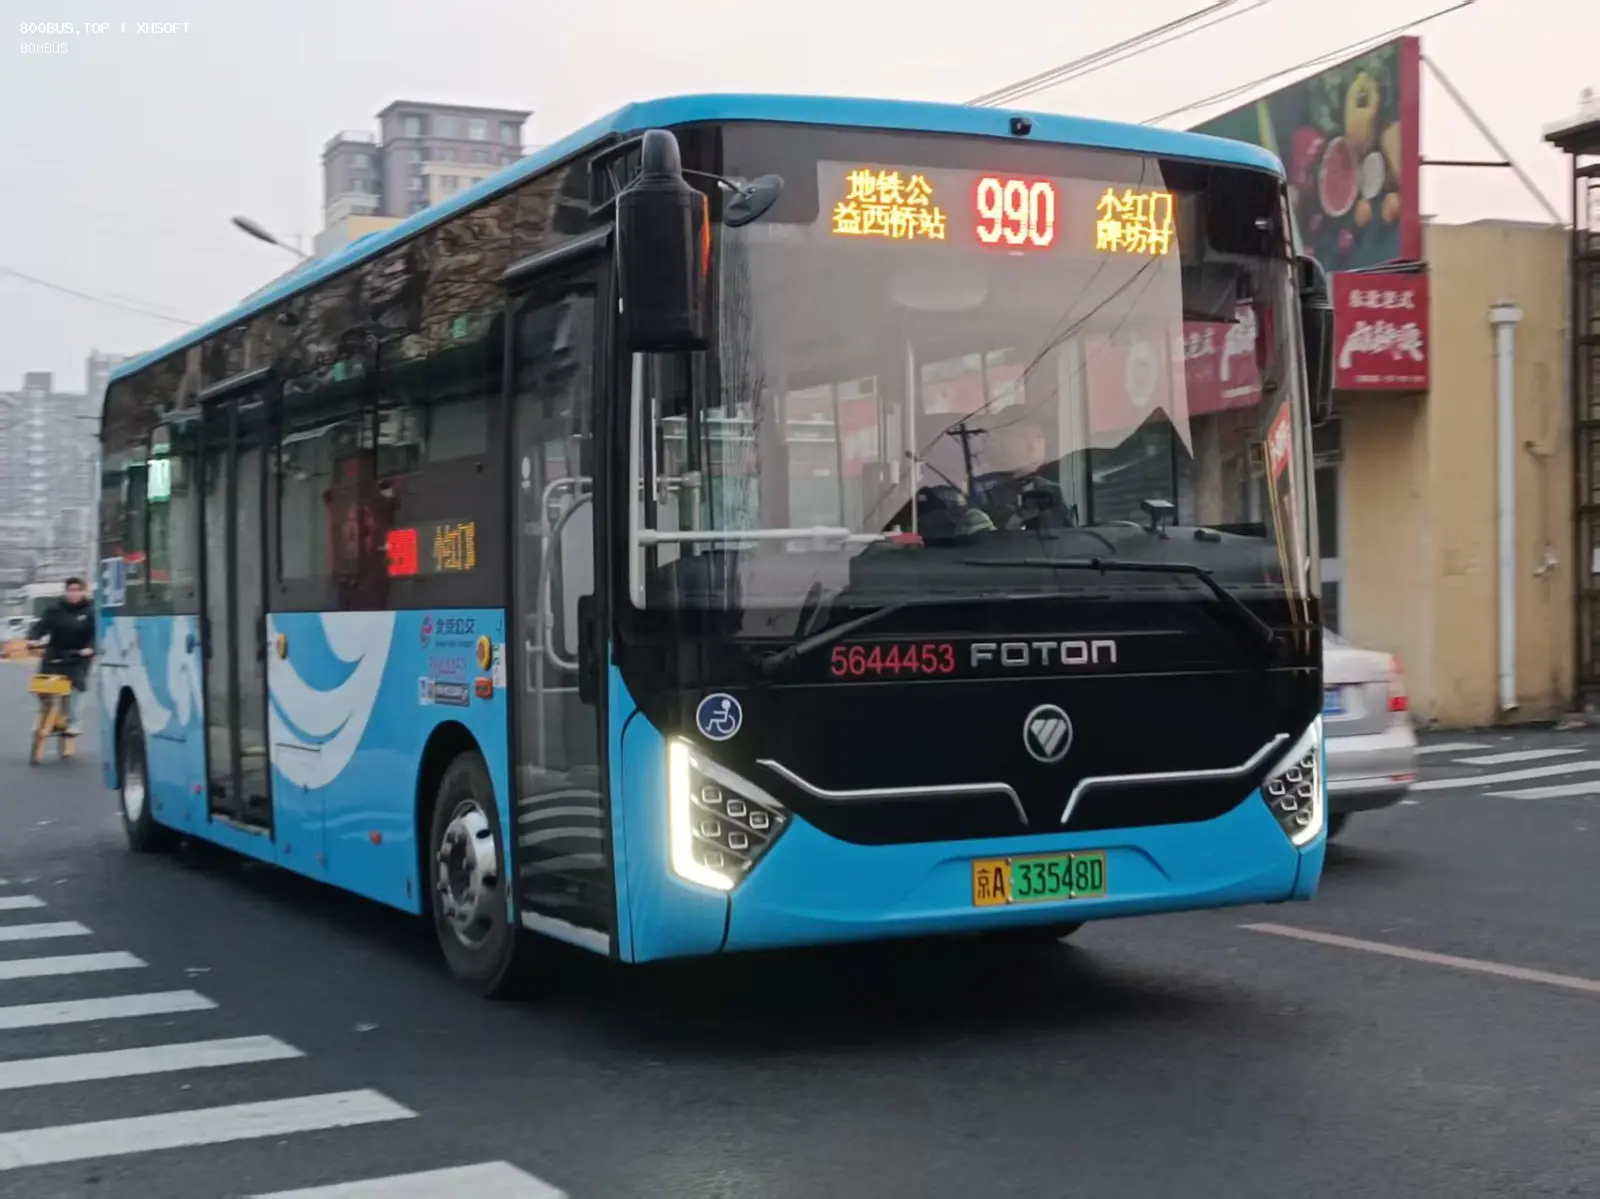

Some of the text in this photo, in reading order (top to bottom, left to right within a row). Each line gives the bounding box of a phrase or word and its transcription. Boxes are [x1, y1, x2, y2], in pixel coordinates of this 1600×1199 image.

[846, 169, 932, 206] 地铁公
[1095, 187, 1173, 223] 小红门
[833, 203, 946, 240] 益西桥站
[976, 177, 1055, 247] 990
[1095, 219, 1174, 255] 牌坊村
[830, 643, 956, 676] 5644453
[970, 639, 1118, 668] FOTON
